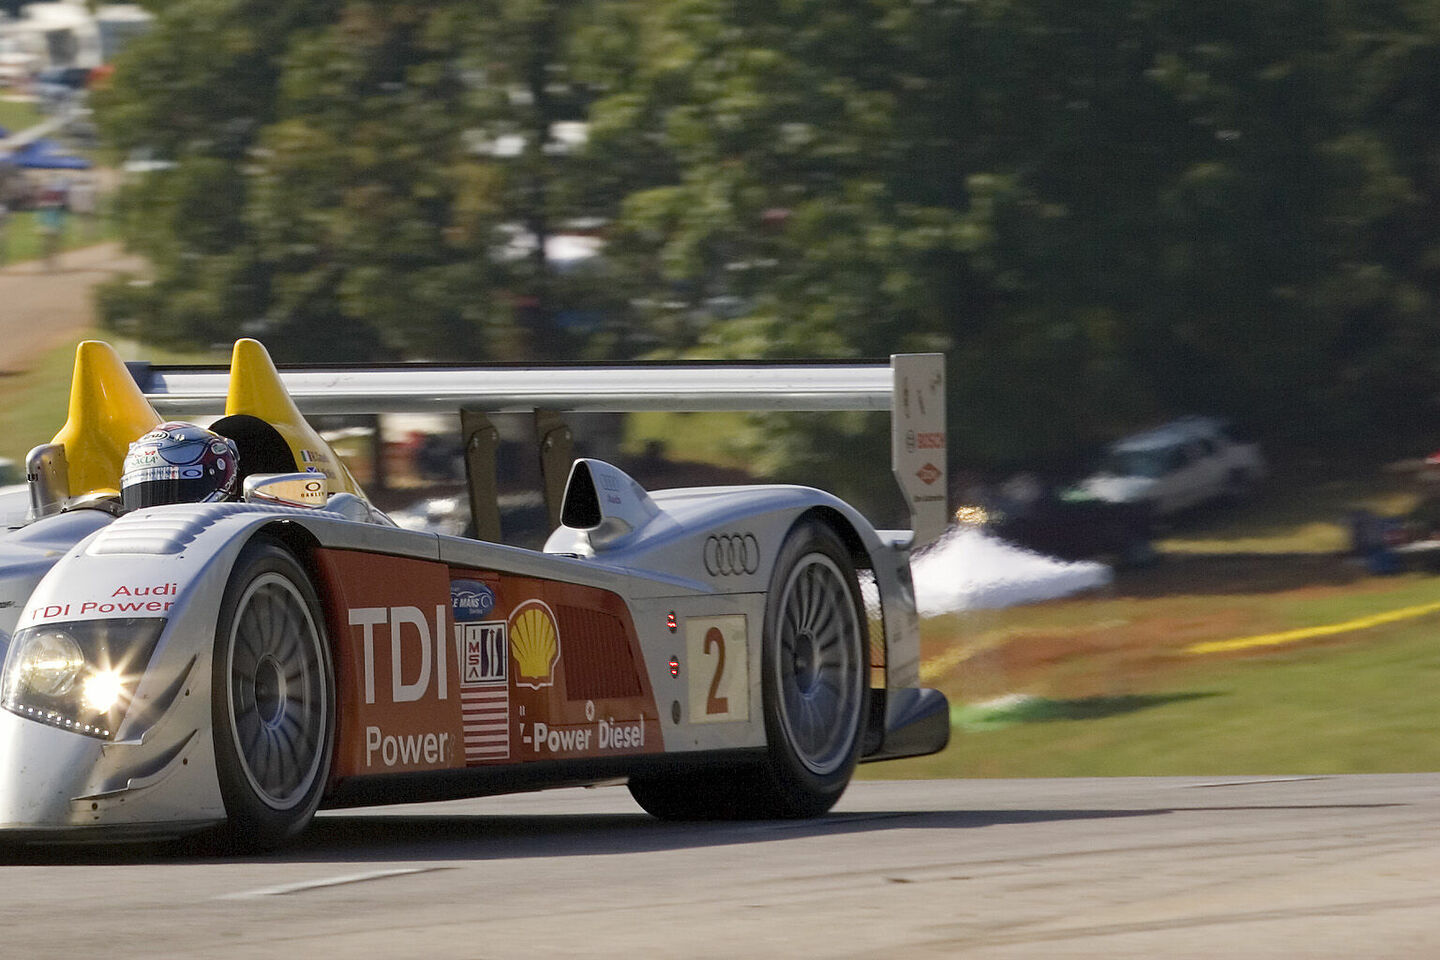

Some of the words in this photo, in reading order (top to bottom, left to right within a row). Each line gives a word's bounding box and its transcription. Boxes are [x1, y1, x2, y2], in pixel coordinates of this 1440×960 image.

[80, 601, 175, 615] Power
[111, 583, 177, 598] Audi
[348, 604, 448, 704] TDI
[703, 626, 729, 715] 2
[365, 725, 449, 767] Power
[598, 713, 645, 750] Diesel
